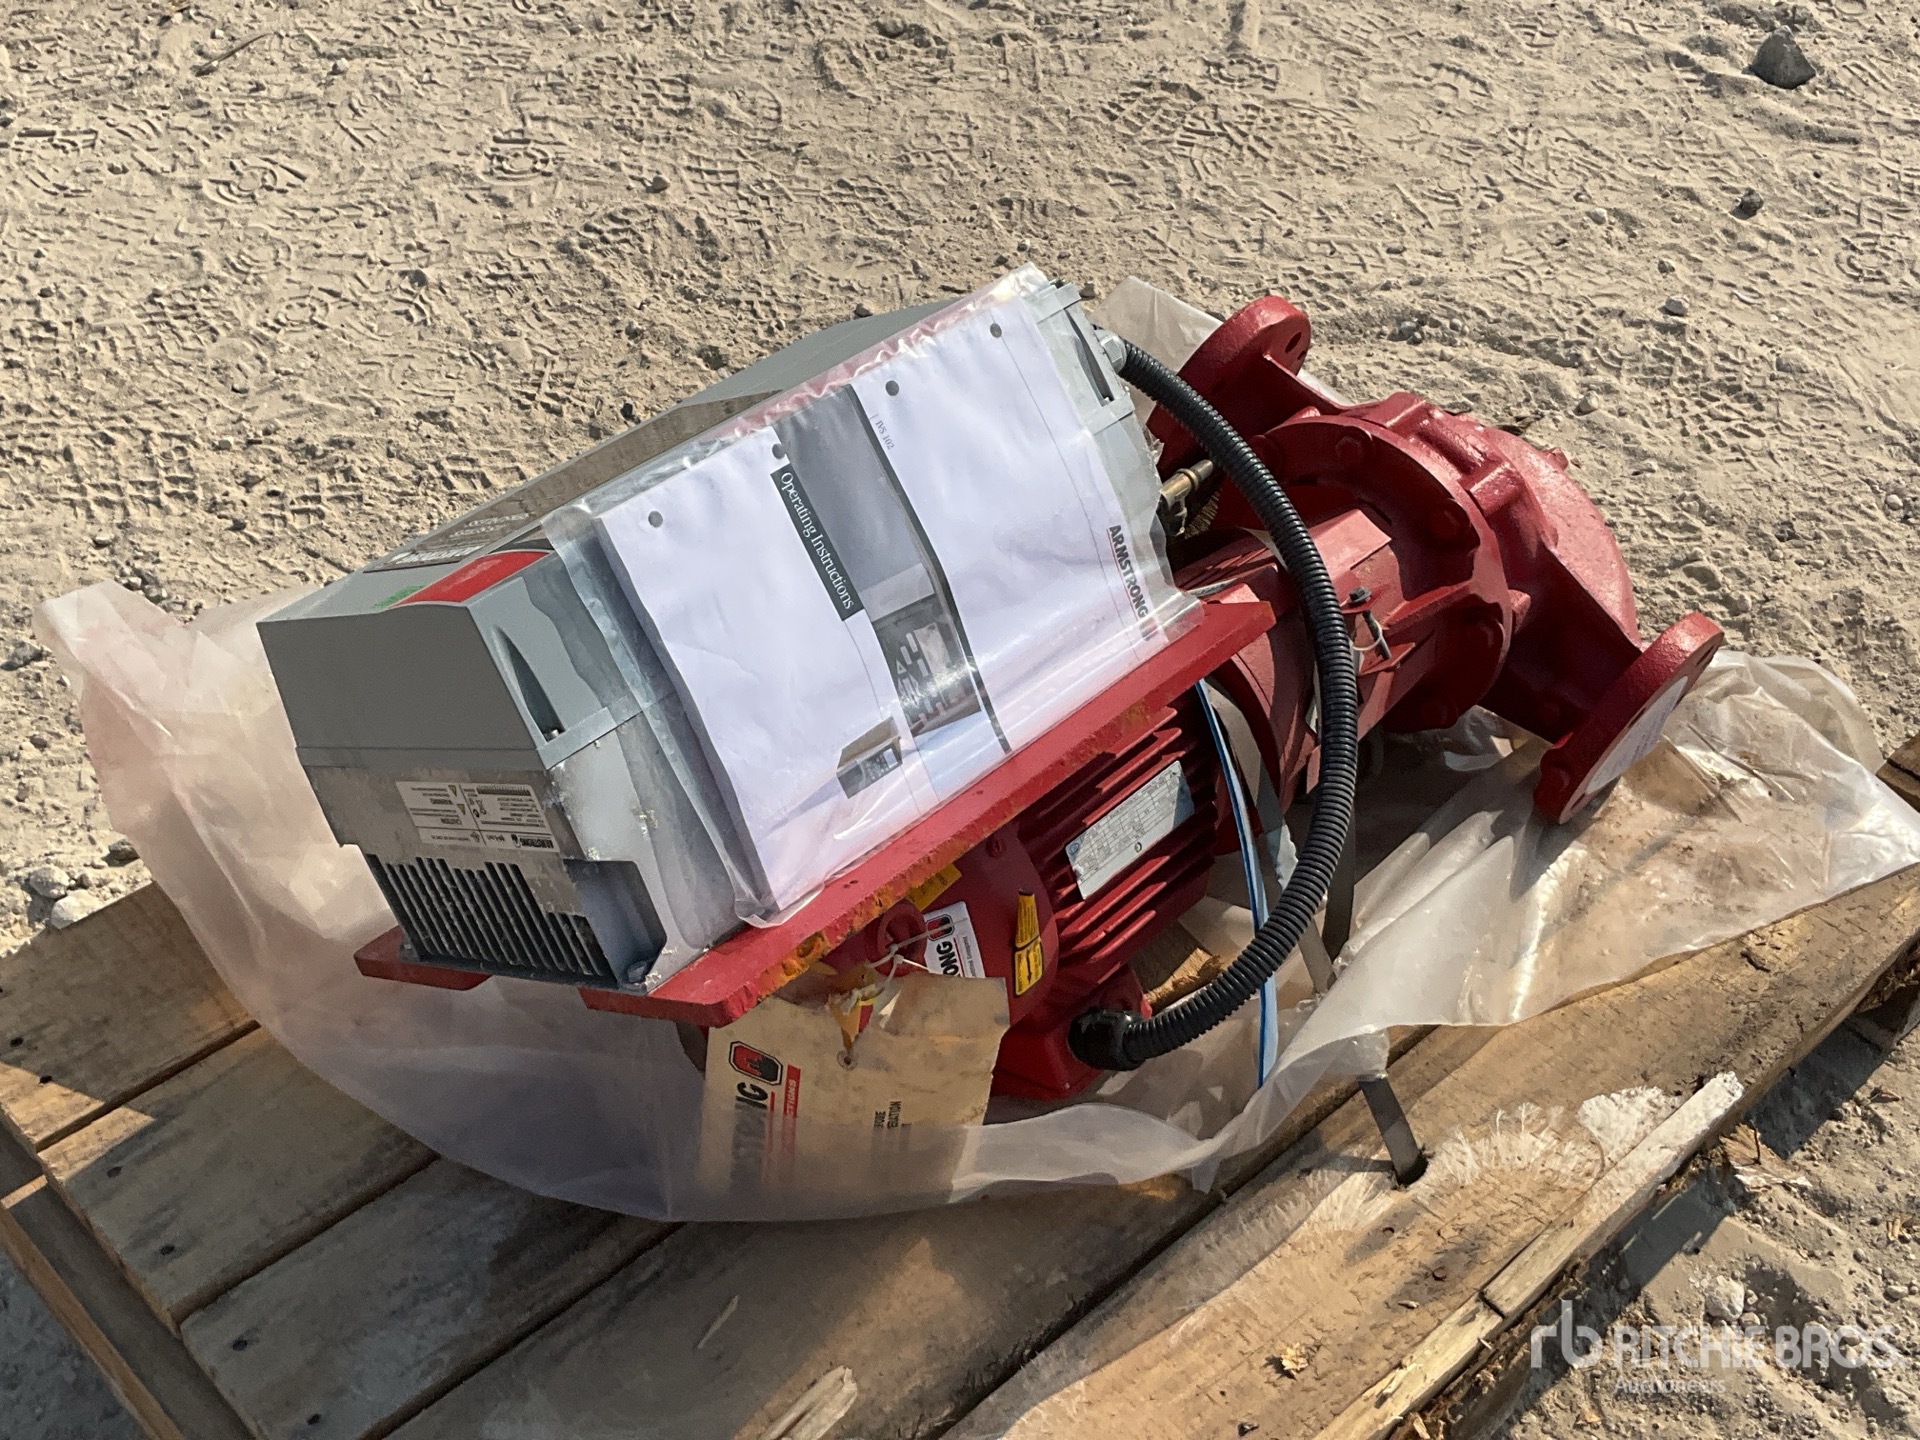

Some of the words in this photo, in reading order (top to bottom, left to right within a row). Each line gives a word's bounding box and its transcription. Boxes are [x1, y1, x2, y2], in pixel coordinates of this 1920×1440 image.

[780, 471, 817, 538] Operating
[812, 533, 855, 610] Instructions
[1108, 524, 1149, 619] ARMSTRONG
